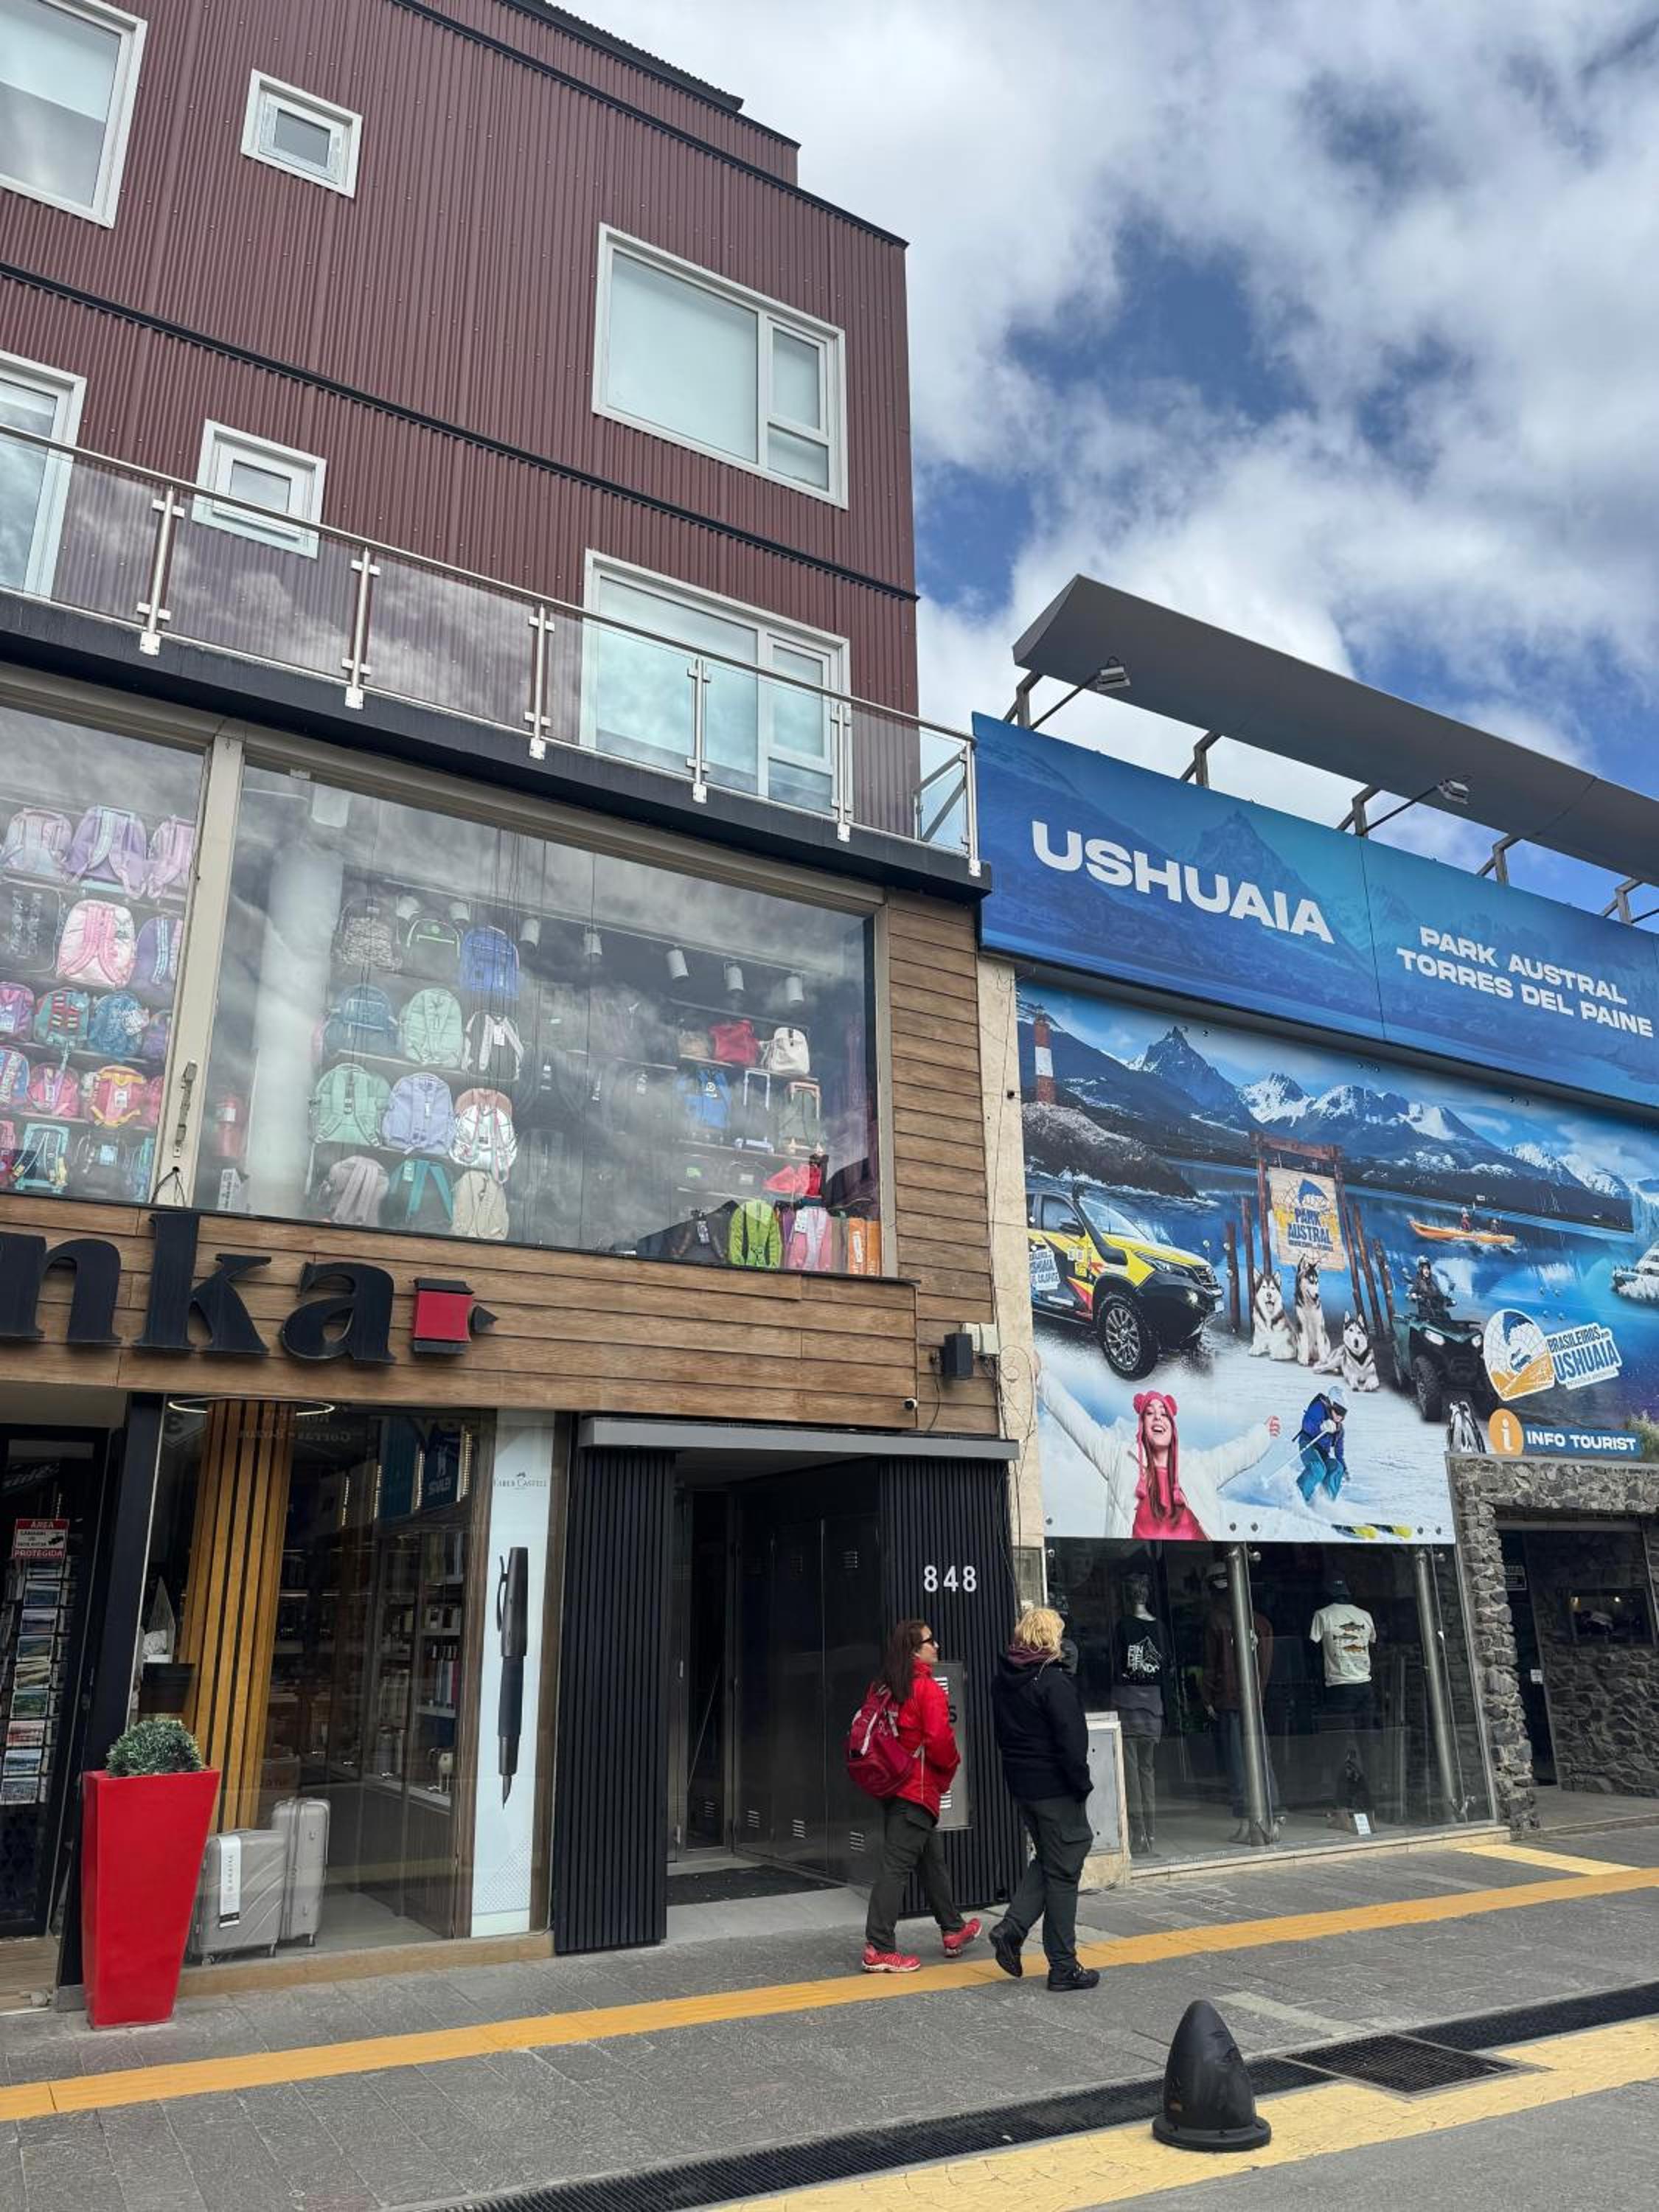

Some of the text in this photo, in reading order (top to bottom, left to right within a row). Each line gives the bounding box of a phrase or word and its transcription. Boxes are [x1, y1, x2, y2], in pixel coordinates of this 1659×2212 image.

[1032, 821, 1335, 944] USHUAIA
[1419, 926, 1627, 1005] PARK AUSTRAL
[1397, 947, 1654, 1038] TORRES DEL PAINE
[1294, 1207, 1321, 1227] PARK
[1287, 1222, 1333, 1245] AUSTRAL
[1546, 1325, 1601, 1353] BRASILEIROS
[1552, 1339, 1620, 1381] USHUAIA
[1526, 1430, 1636, 1451] INFO TOURIST
[14, 1549, 63, 1558] PROTEGIDA
[924, 1565, 977, 1593] 848
